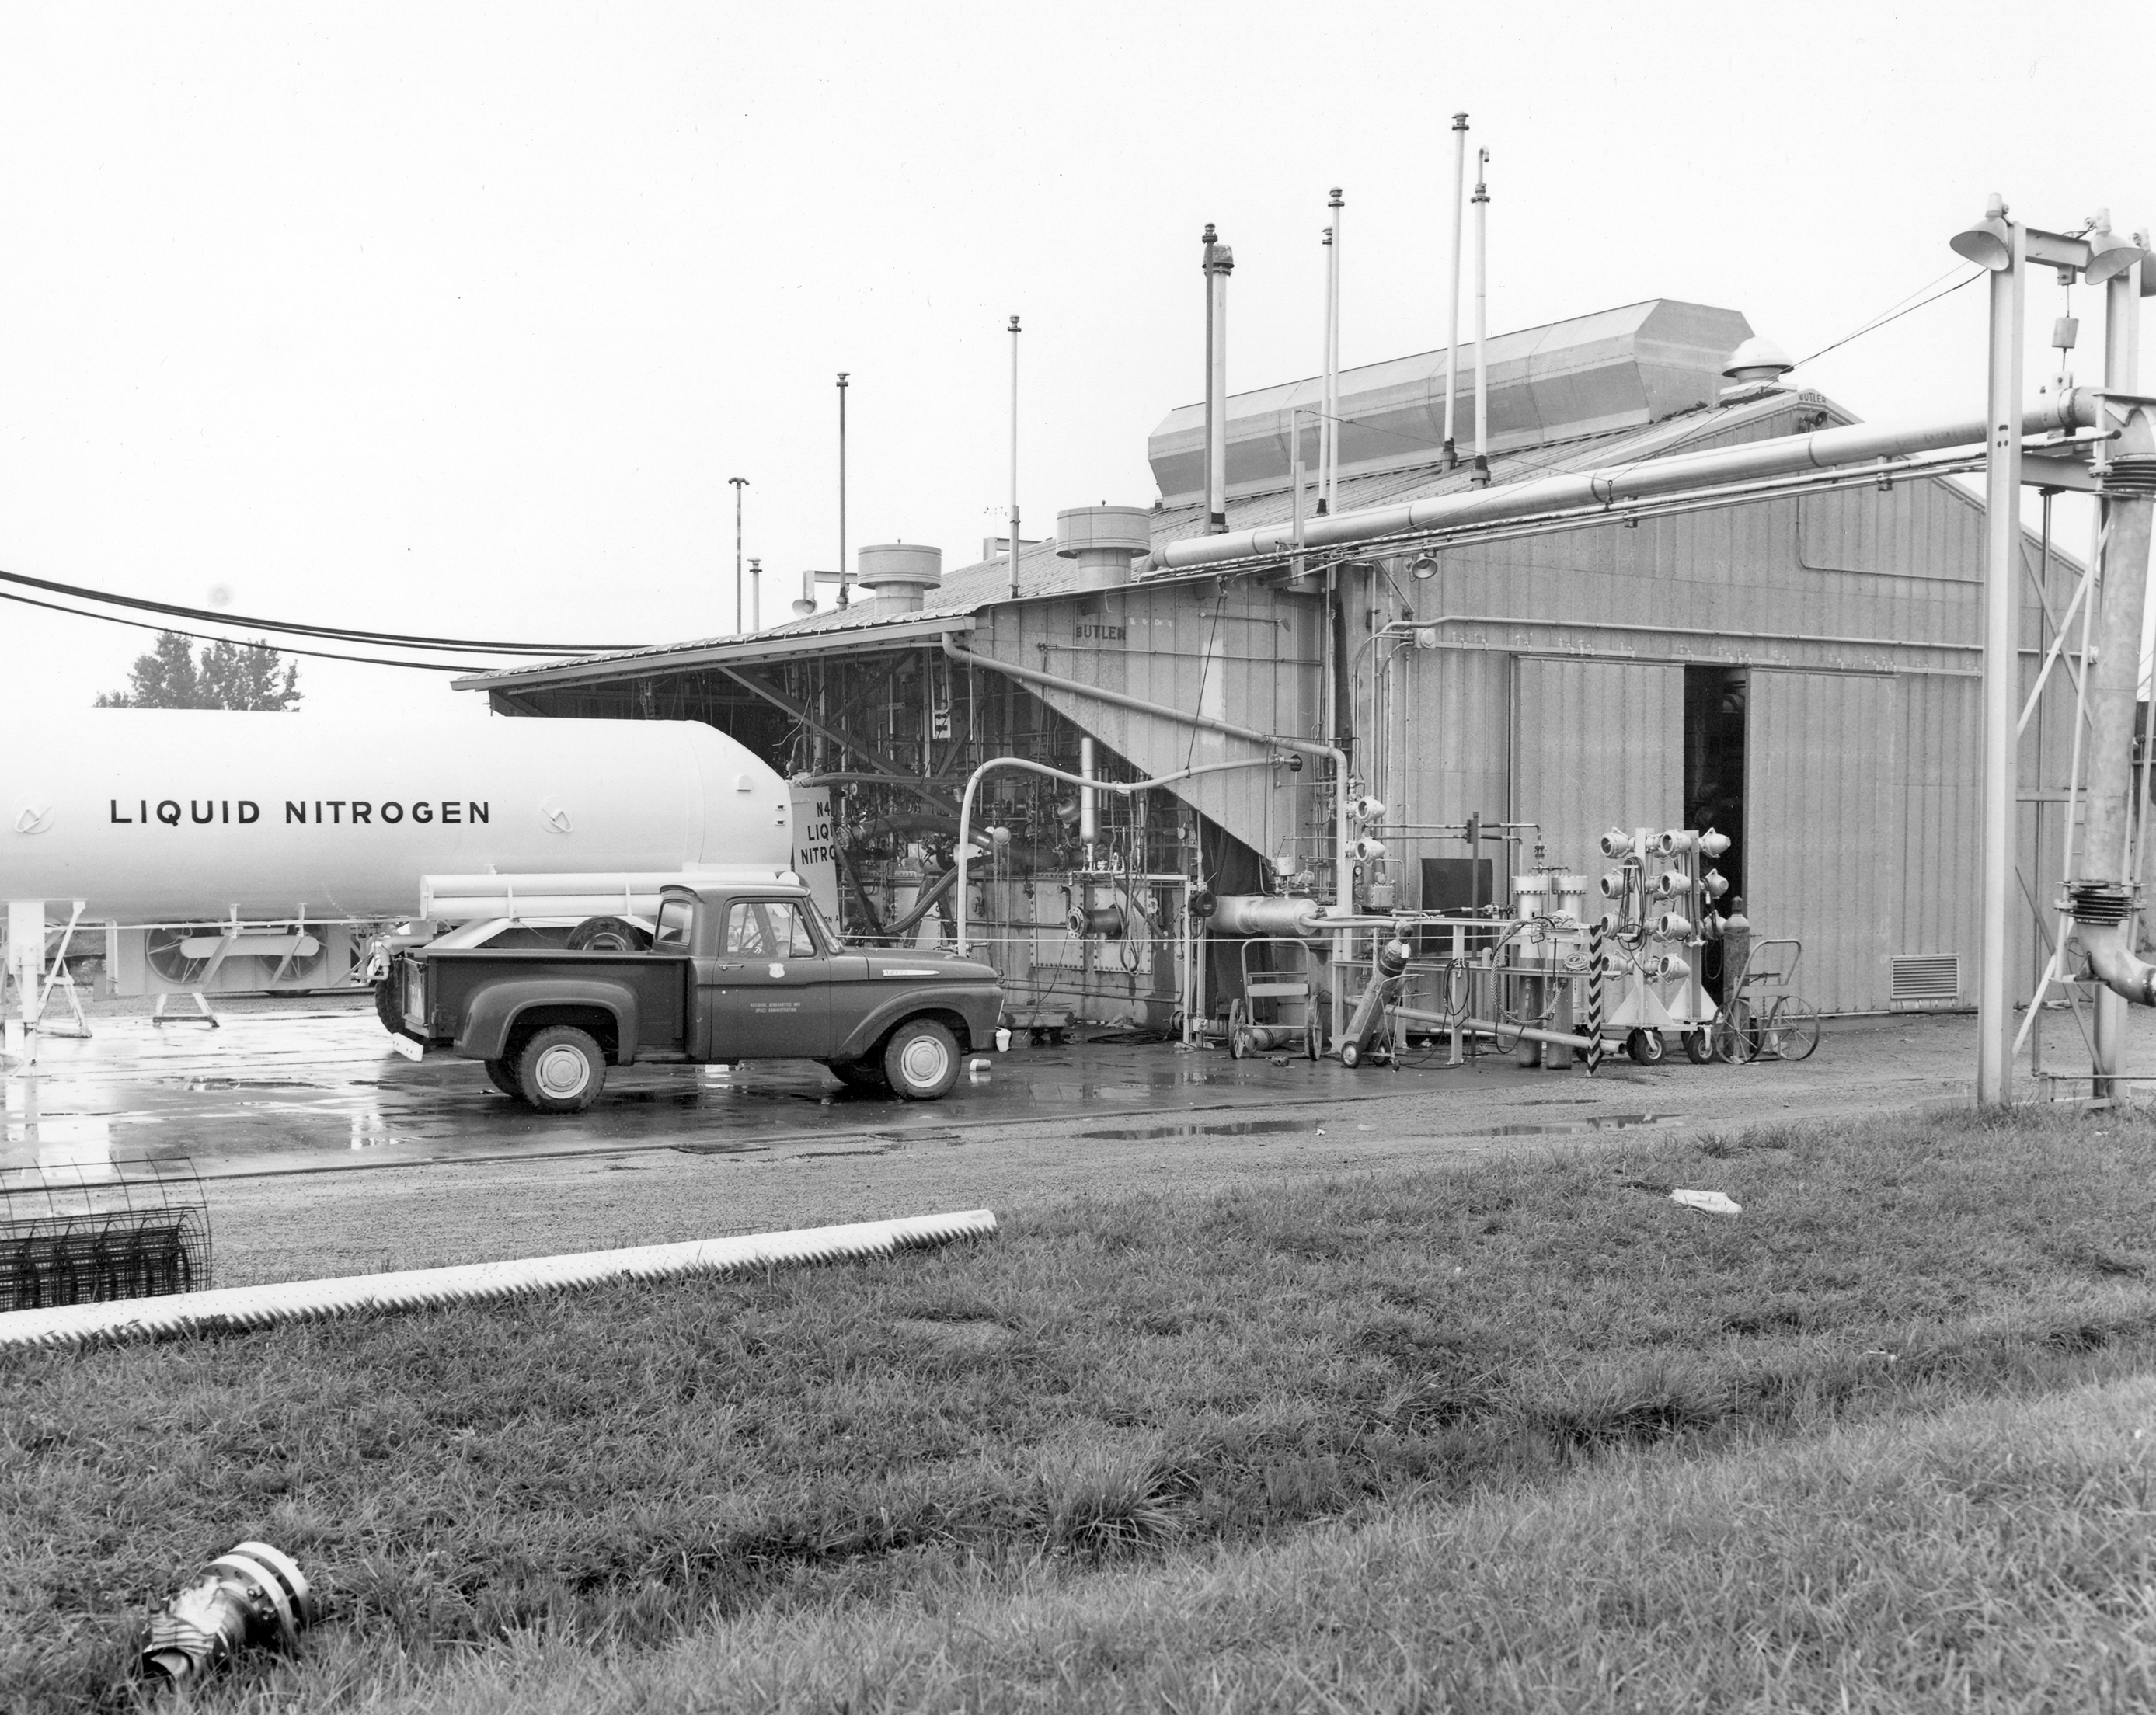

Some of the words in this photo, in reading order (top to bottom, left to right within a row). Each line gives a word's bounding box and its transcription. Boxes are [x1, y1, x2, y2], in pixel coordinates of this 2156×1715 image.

[1799, 392, 1827, 404] BUTLER
[110, 799, 260, 827] LIQUID
[285, 801, 489, 824] NITROGEN
